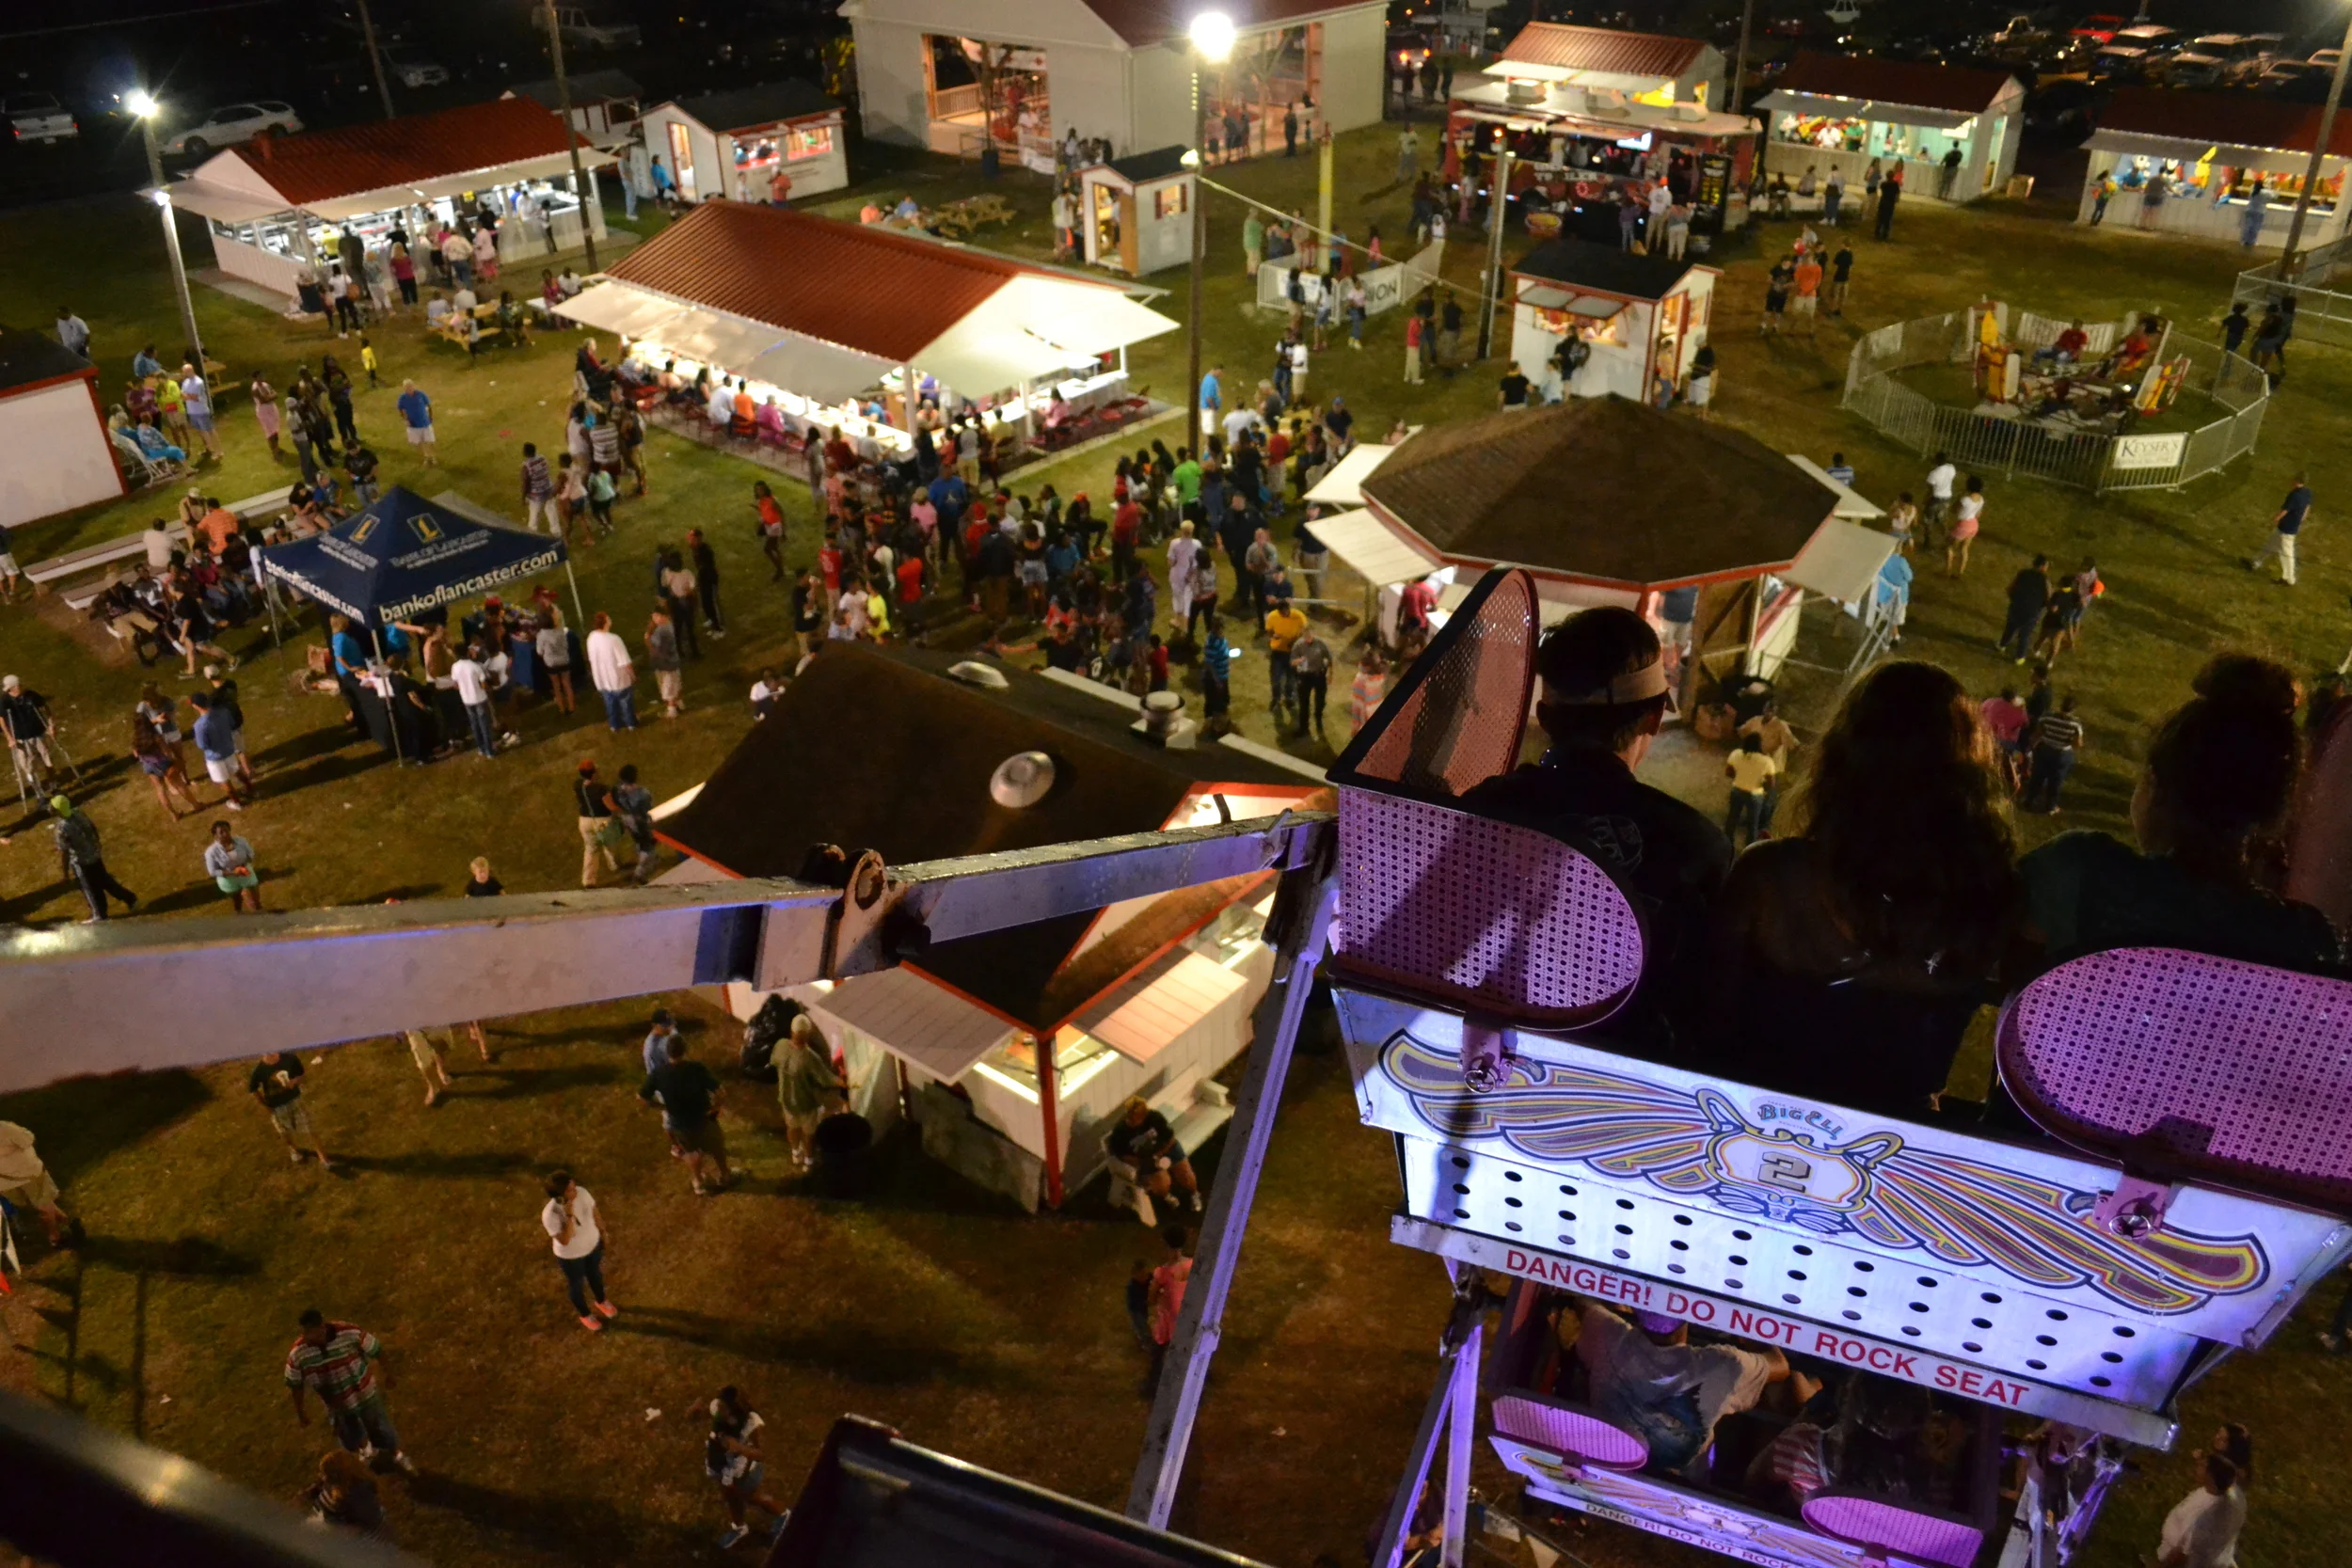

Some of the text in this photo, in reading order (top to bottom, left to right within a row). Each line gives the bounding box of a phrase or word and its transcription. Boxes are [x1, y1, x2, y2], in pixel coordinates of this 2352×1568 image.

[379, 549, 559, 623] bankoflancaster.com
[1757, 1103, 1802, 1121] BIG
[1757, 1151, 1811, 1194] 2
[1506, 1249, 2029, 1406] DANGER! DO NOT ROCK SEAT
[1585, 1503, 1661, 1532] DANGER!
[1667, 1528, 1692, 1542] DO
[1700, 1538, 1732, 1554] NOT
